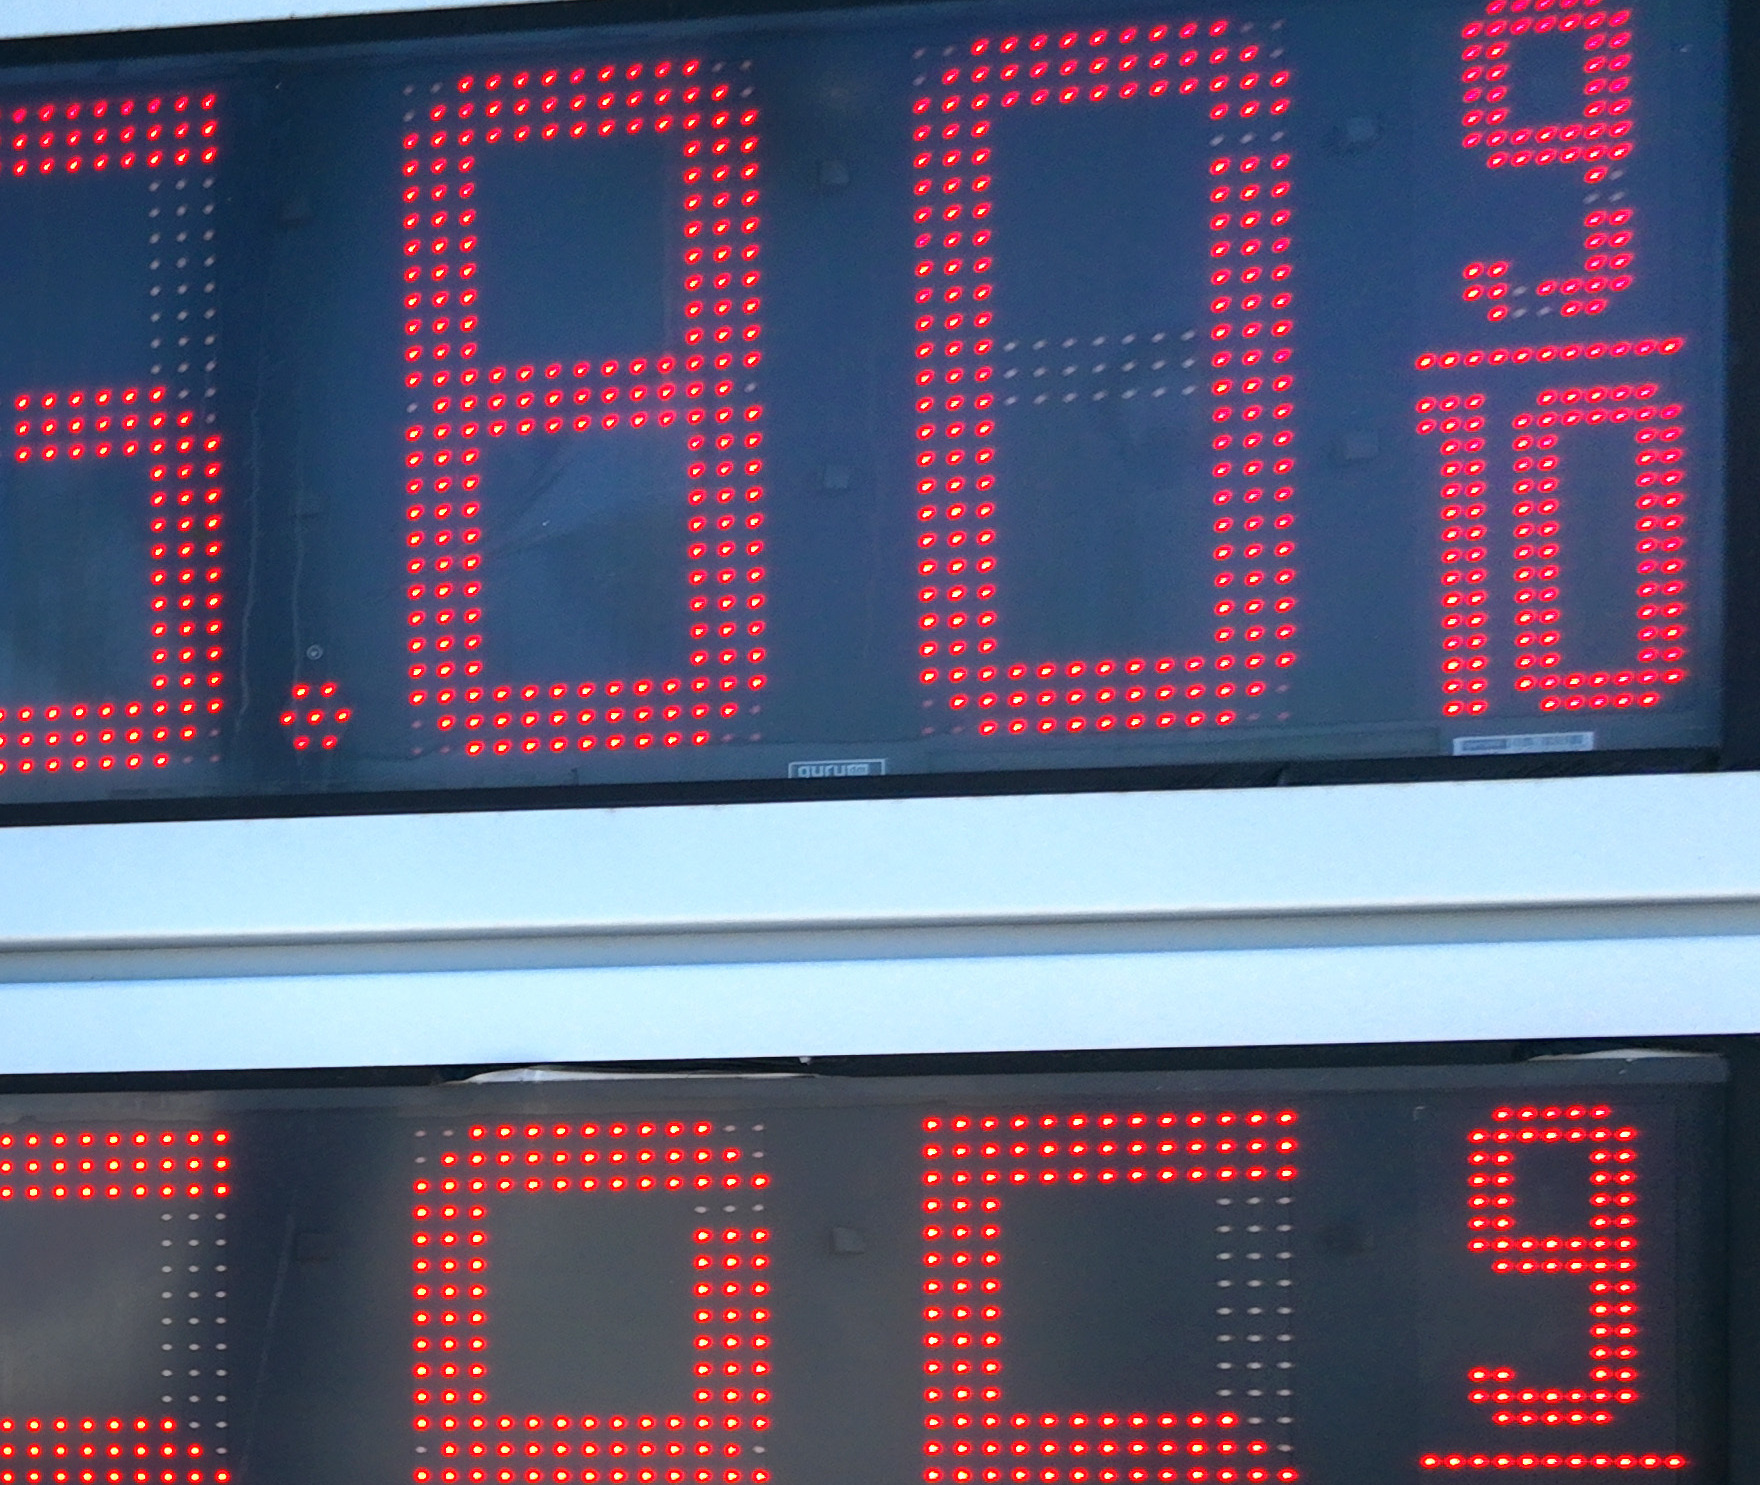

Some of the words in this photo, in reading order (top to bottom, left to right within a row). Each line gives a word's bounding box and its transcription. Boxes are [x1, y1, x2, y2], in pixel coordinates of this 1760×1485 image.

[1461, 0, 1634, 322] 9
[1415, 382, 1687, 717] 10
[1467, 1104, 1640, 1426] 9
